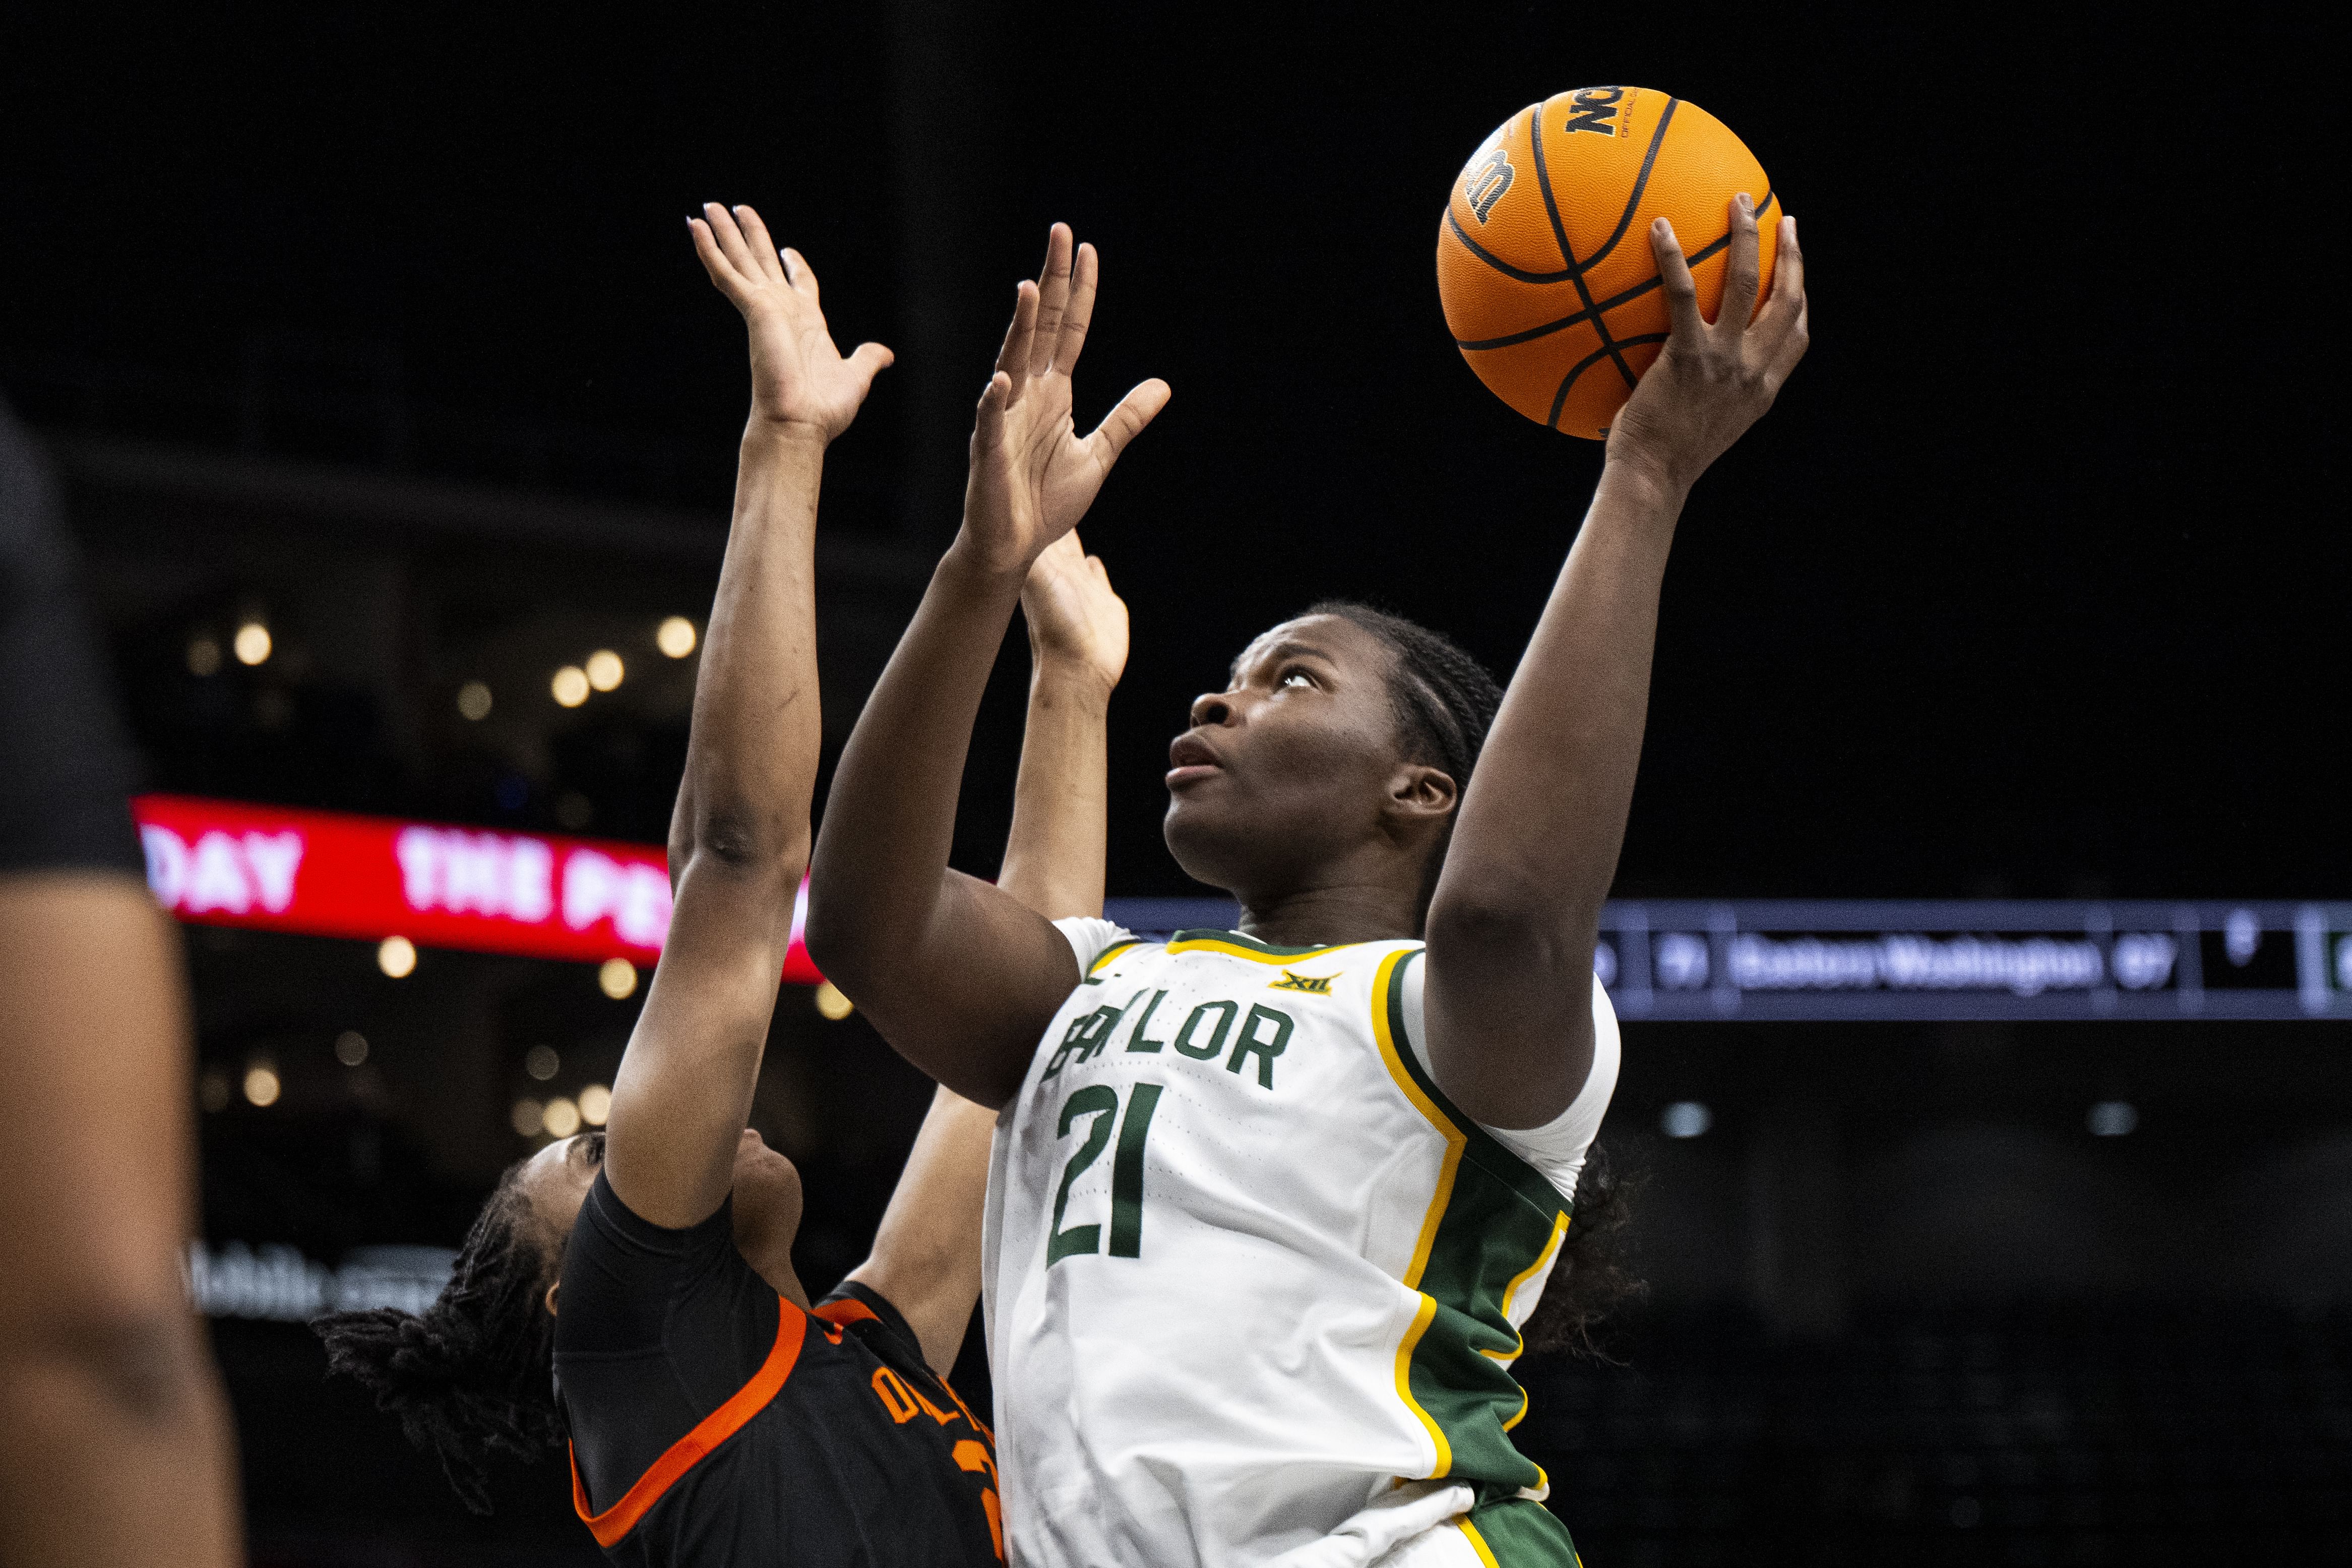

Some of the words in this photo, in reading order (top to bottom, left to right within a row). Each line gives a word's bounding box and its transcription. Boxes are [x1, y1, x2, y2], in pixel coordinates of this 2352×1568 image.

[399, 825, 551, 924] THE
[1878, 931, 2103, 997] Washington
[1046, 1082, 1164, 1271] 21
